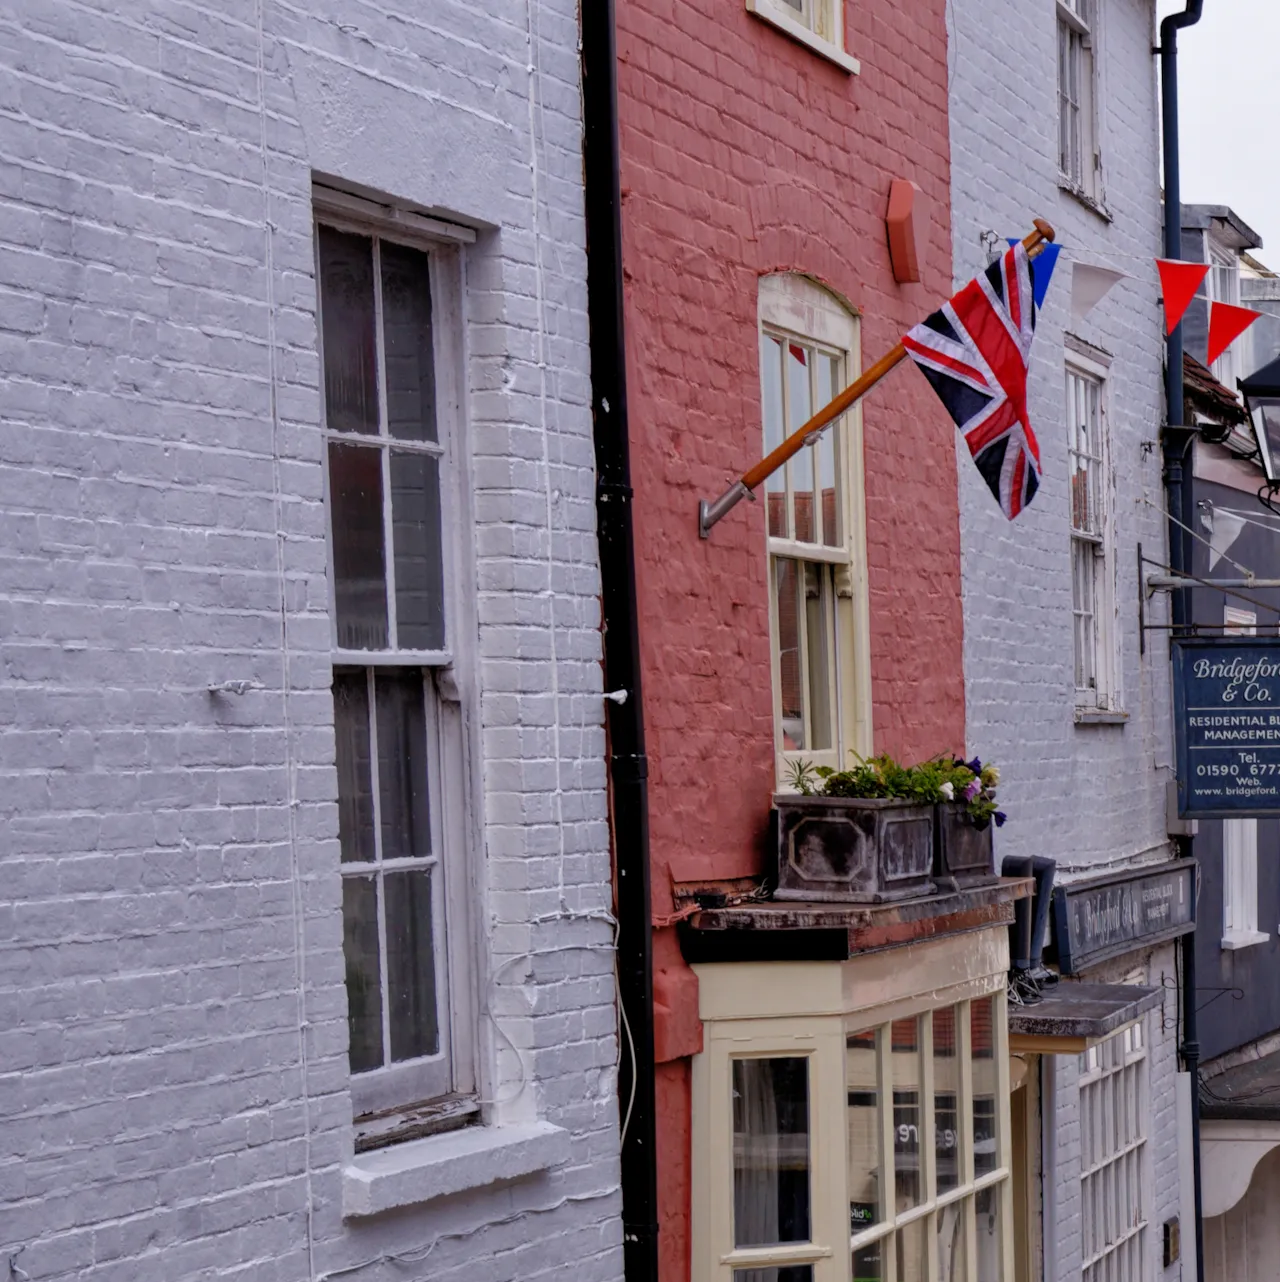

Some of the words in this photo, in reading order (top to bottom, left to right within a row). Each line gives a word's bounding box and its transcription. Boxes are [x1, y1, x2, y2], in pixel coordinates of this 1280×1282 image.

[1222, 683, 1238, 702] &
[1244, 683, 1272, 701] Co.
[1189, 716, 1266, 727] RESIDENTIAL
[1238, 752, 1260, 763] Tel.
[1196, 765, 1239, 776] 01590
[1236, 776, 1262, 786] Web.
